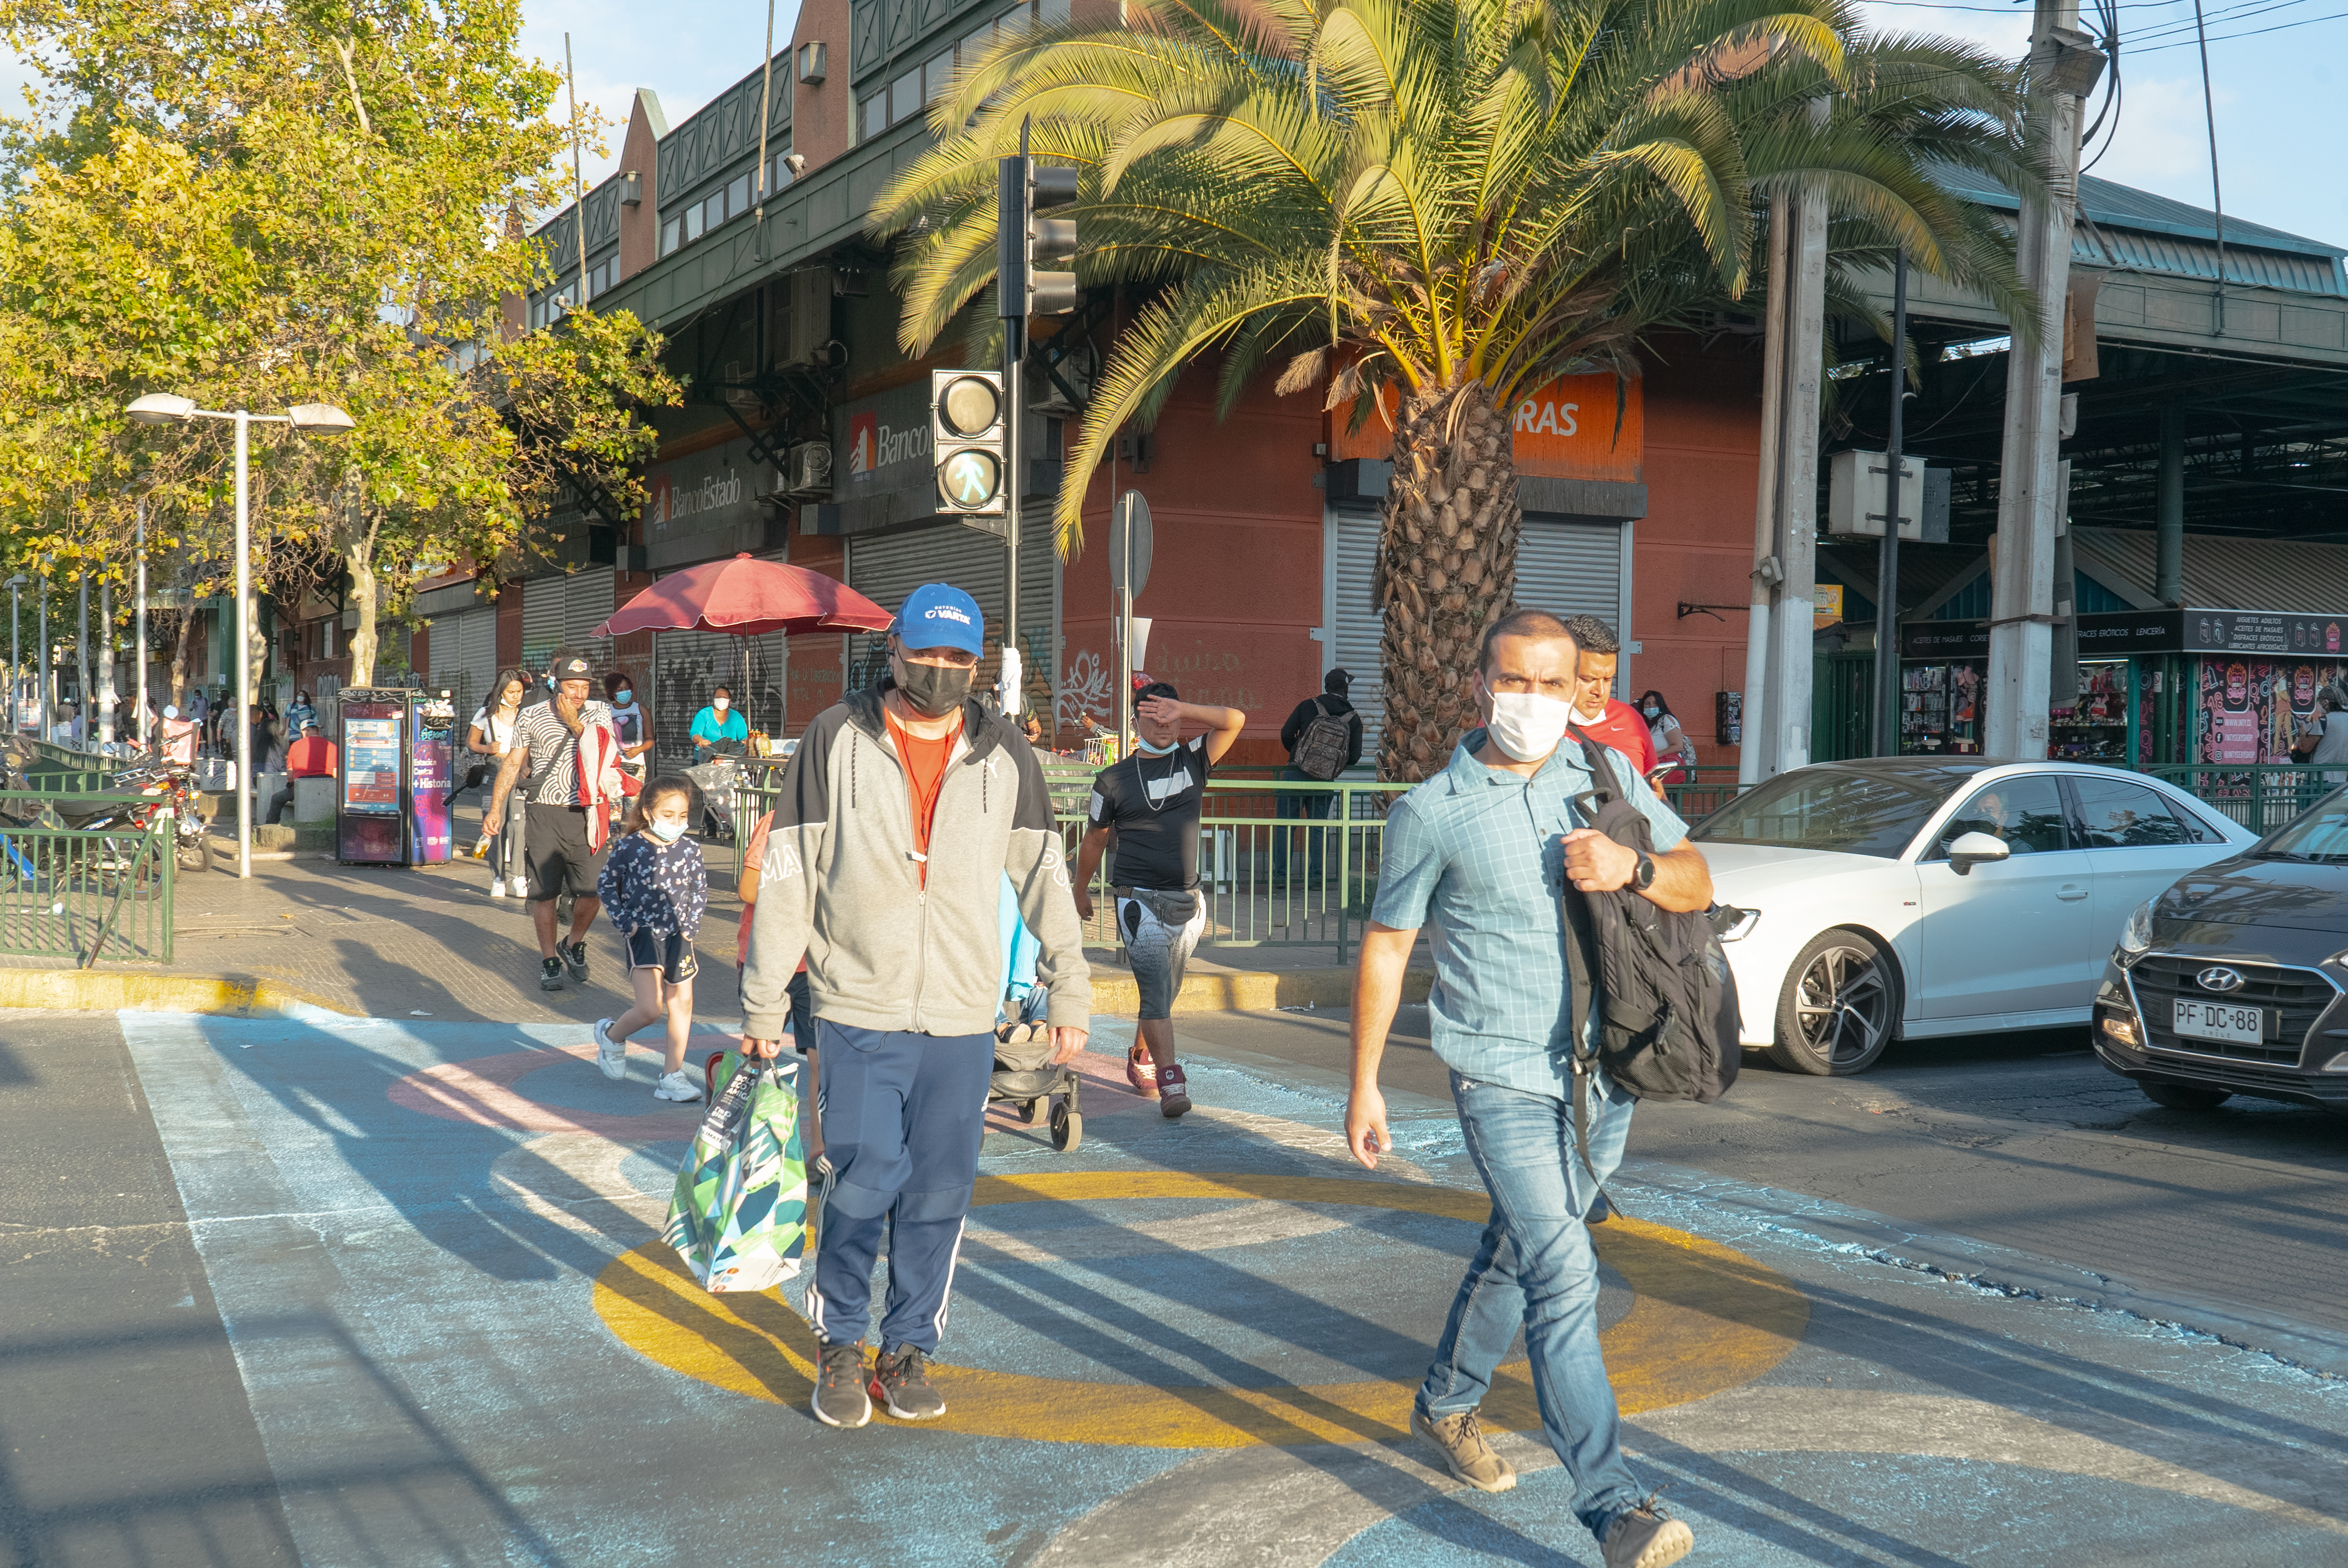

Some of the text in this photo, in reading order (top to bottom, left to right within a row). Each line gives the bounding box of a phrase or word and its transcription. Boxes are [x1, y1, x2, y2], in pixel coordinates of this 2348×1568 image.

[1513, 400, 1579, 437] RAS
[671, 468, 741, 520] BancoEstado
[938, 610, 970, 625] VARTA
[2077, 630, 2097, 638] FRACES
[420, 777, 451, 789] Historia
[758, 844, 804, 890] MA
[1035, 847, 1072, 894] PU
[2202, 1028, 2232, 1039] CHILE
[730, 1081, 748, 1091] ECO
